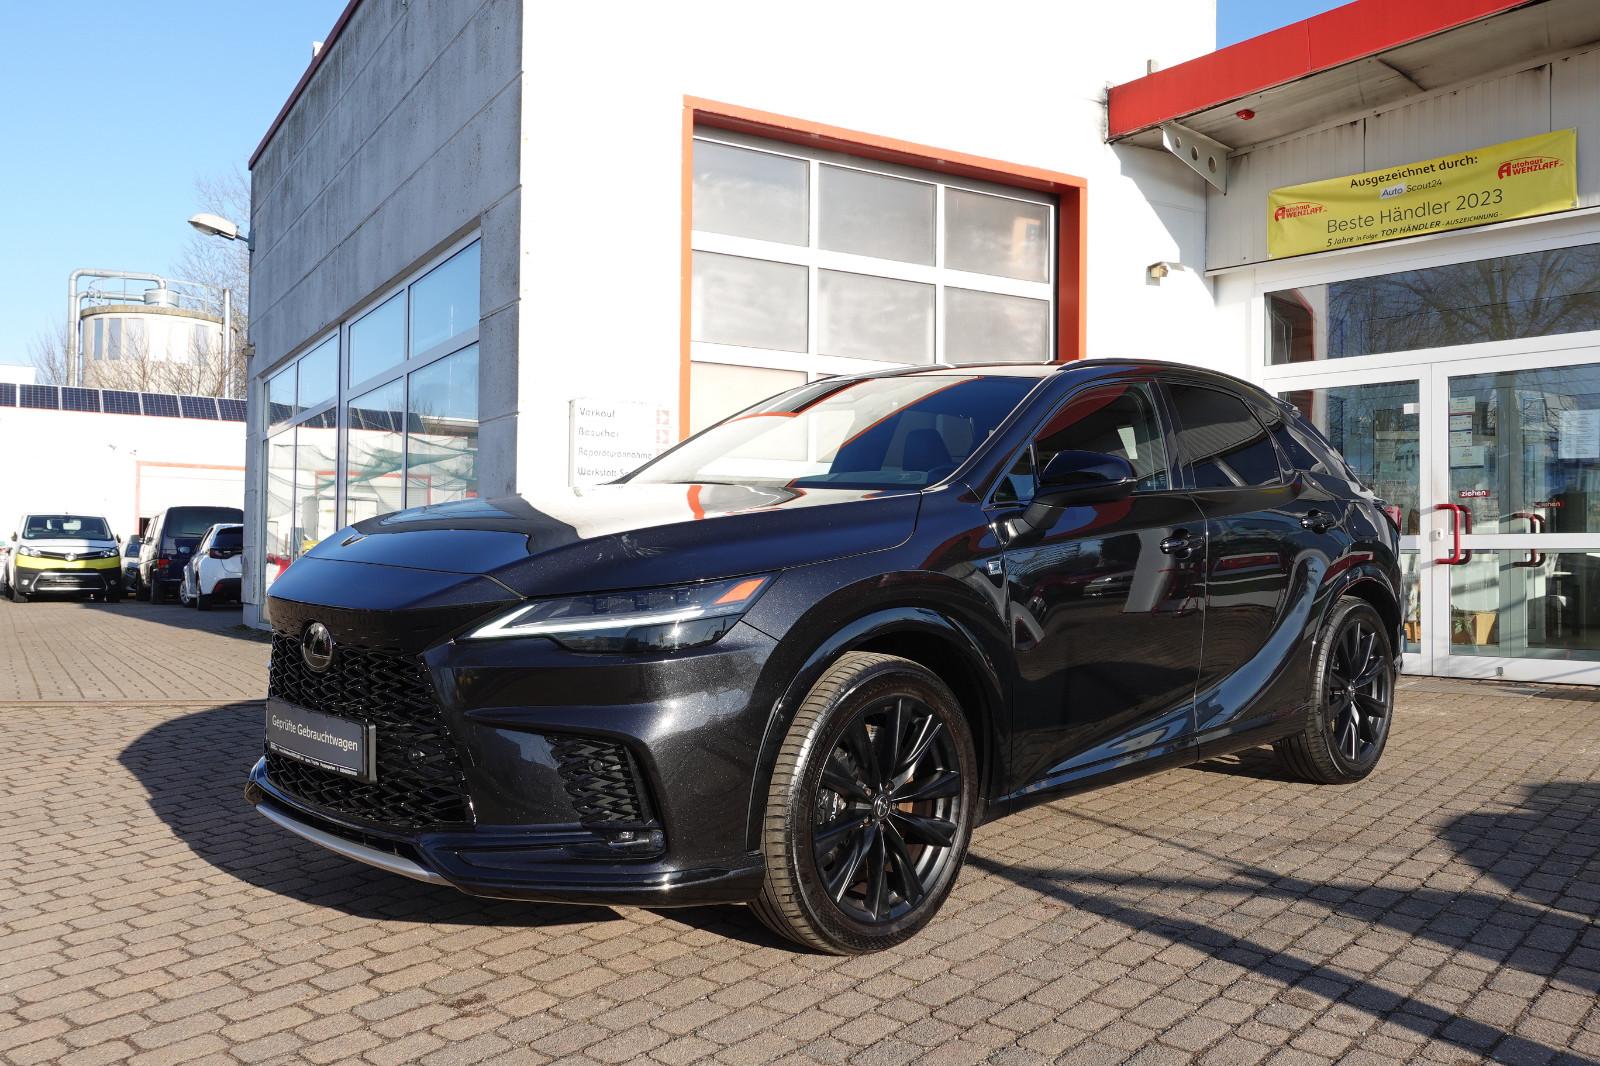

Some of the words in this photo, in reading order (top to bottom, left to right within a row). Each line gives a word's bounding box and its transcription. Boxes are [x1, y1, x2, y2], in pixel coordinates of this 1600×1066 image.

[1350, 165, 1436, 188] Ausgezeichnet
[1438, 155, 1478, 171] durch:
[1498, 158, 1543, 180] Autohaus
[1512, 160, 1559, 176] WENZLAFF
[1381, 187, 1404, 198] Auto
[1406, 179, 1443, 193] Scout24
[1285, 206, 1322, 218] WENZLAFF
[1327, 213, 1375, 234] Beste
[1380, 199, 1451, 225] Händler
[1456, 189, 1504, 212] 2023
[1326, 238, 1333, 248] 5
[1334, 236, 1354, 245] Jahre
[1381, 228, 1398, 238] TOP
[1400, 222, 1441, 233] HÄNDLER
[1445, 212, 1499, 225] AUSZEICHNUNG
[579, 407, 615, 418] Verkauf
[578, 426, 619, 438] Besucher
[578, 447, 653, 460] Reparaturannahme
[1460, 489, 1486, 497] ziehen
[272, 714, 297, 733] Geprüfte
[297, 723, 358, 752] Gebrauchtwagen
